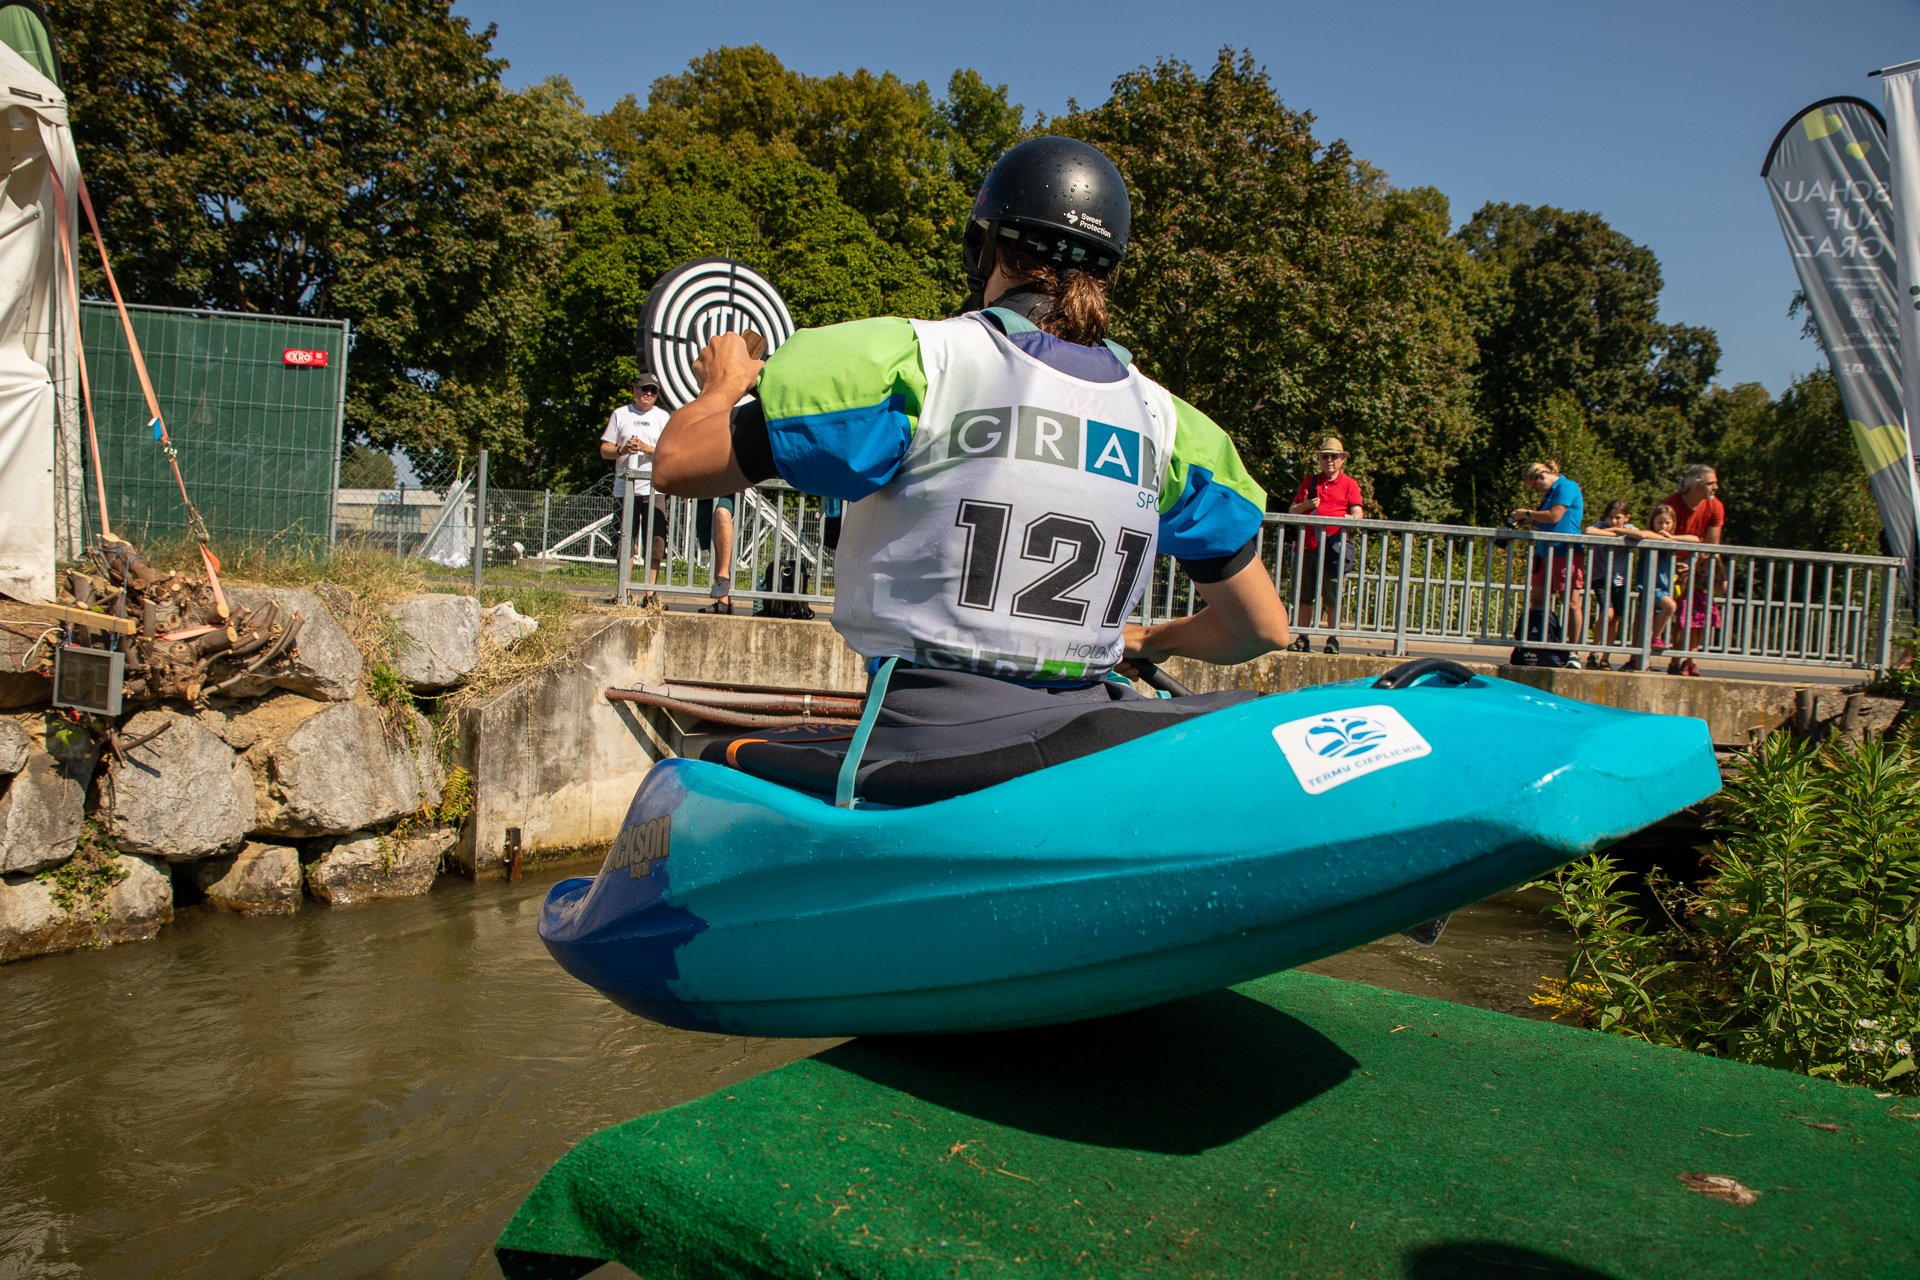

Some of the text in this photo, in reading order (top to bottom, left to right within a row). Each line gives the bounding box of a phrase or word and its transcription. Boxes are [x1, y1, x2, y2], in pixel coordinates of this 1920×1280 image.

[1080, 220, 1112, 238] Protection
[1081, 212, 1102, 226] Sweet
[957, 413, 1160, 486] GRA
[955, 498, 1152, 629] 121
